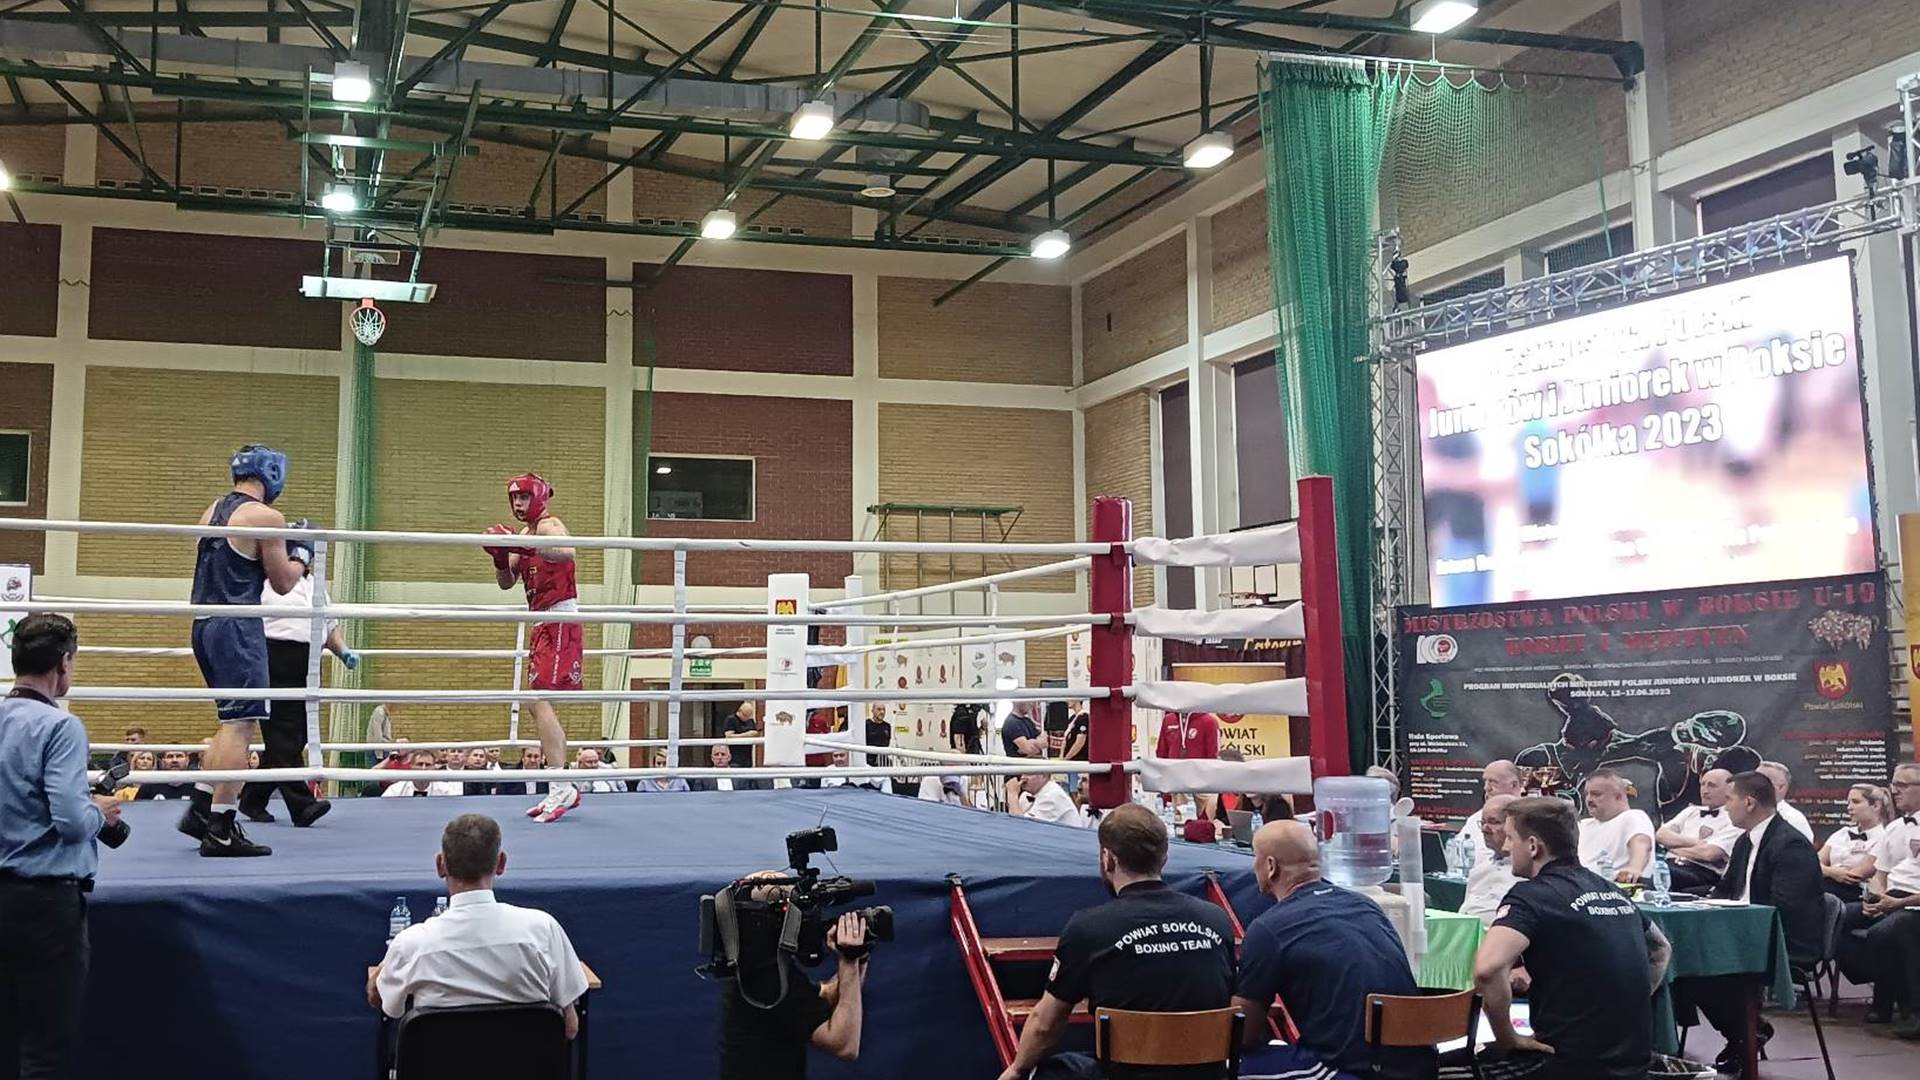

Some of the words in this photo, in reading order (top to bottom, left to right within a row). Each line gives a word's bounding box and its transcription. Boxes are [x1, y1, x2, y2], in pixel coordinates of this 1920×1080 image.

[1428, 388, 1544, 439] Juniów
[1562, 358, 1692, 415] Juniorek
[1693, 354, 1723, 390] w
[1524, 421, 1639, 470] Sokółka
[1642, 403, 1724, 451] 2023
[1562, 600, 1650, 625] POLSKI
[1464, 682, 1500, 690] PROGRAM
[1622, 679, 1652, 687] POLSKI
[1653, 676, 1699, 686] JUNIORÓW
[1707, 675, 1752, 684] JUNIOREK
[1764, 673, 1797, 681] BOKSIE
[1219, 728, 1258, 740] WIAT
[1114, 924, 1159, 951] POWIAT
[1161, 921, 1223, 946] SOKÓLSKI
[1134, 941, 1180, 955] BOXING
[1180, 938, 1213, 951] TEAM
